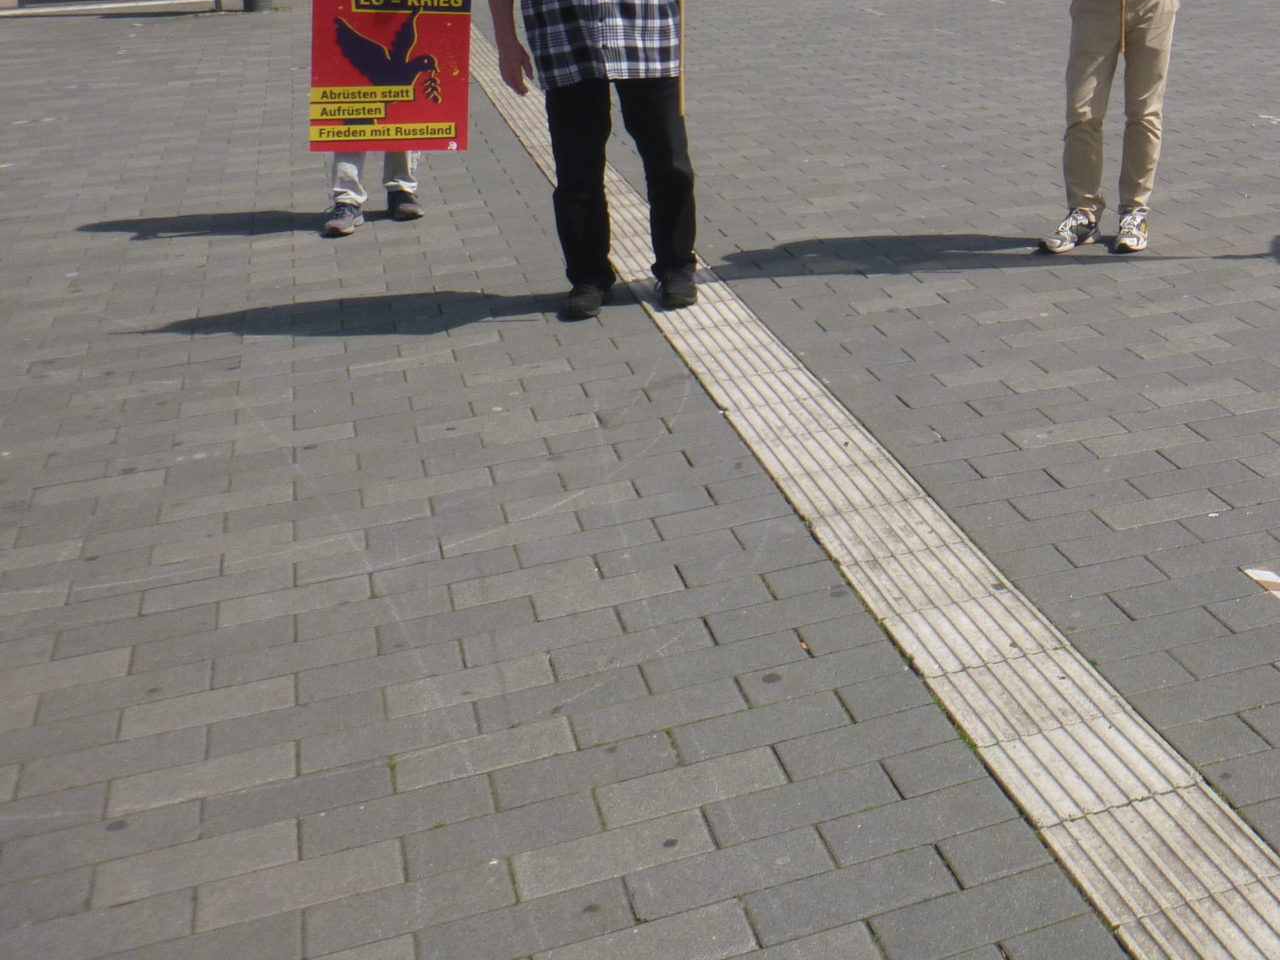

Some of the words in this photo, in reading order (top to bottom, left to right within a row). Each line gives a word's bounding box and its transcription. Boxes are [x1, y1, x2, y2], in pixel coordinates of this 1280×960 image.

[320, 89, 377, 100] Abrüsten
[380, 88, 410, 99] statt
[320, 106, 382, 117] Aufrüsten
[319, 127, 366, 138] Frieden
[370, 126, 391, 137] mit
[395, 125, 452, 137] Russland
